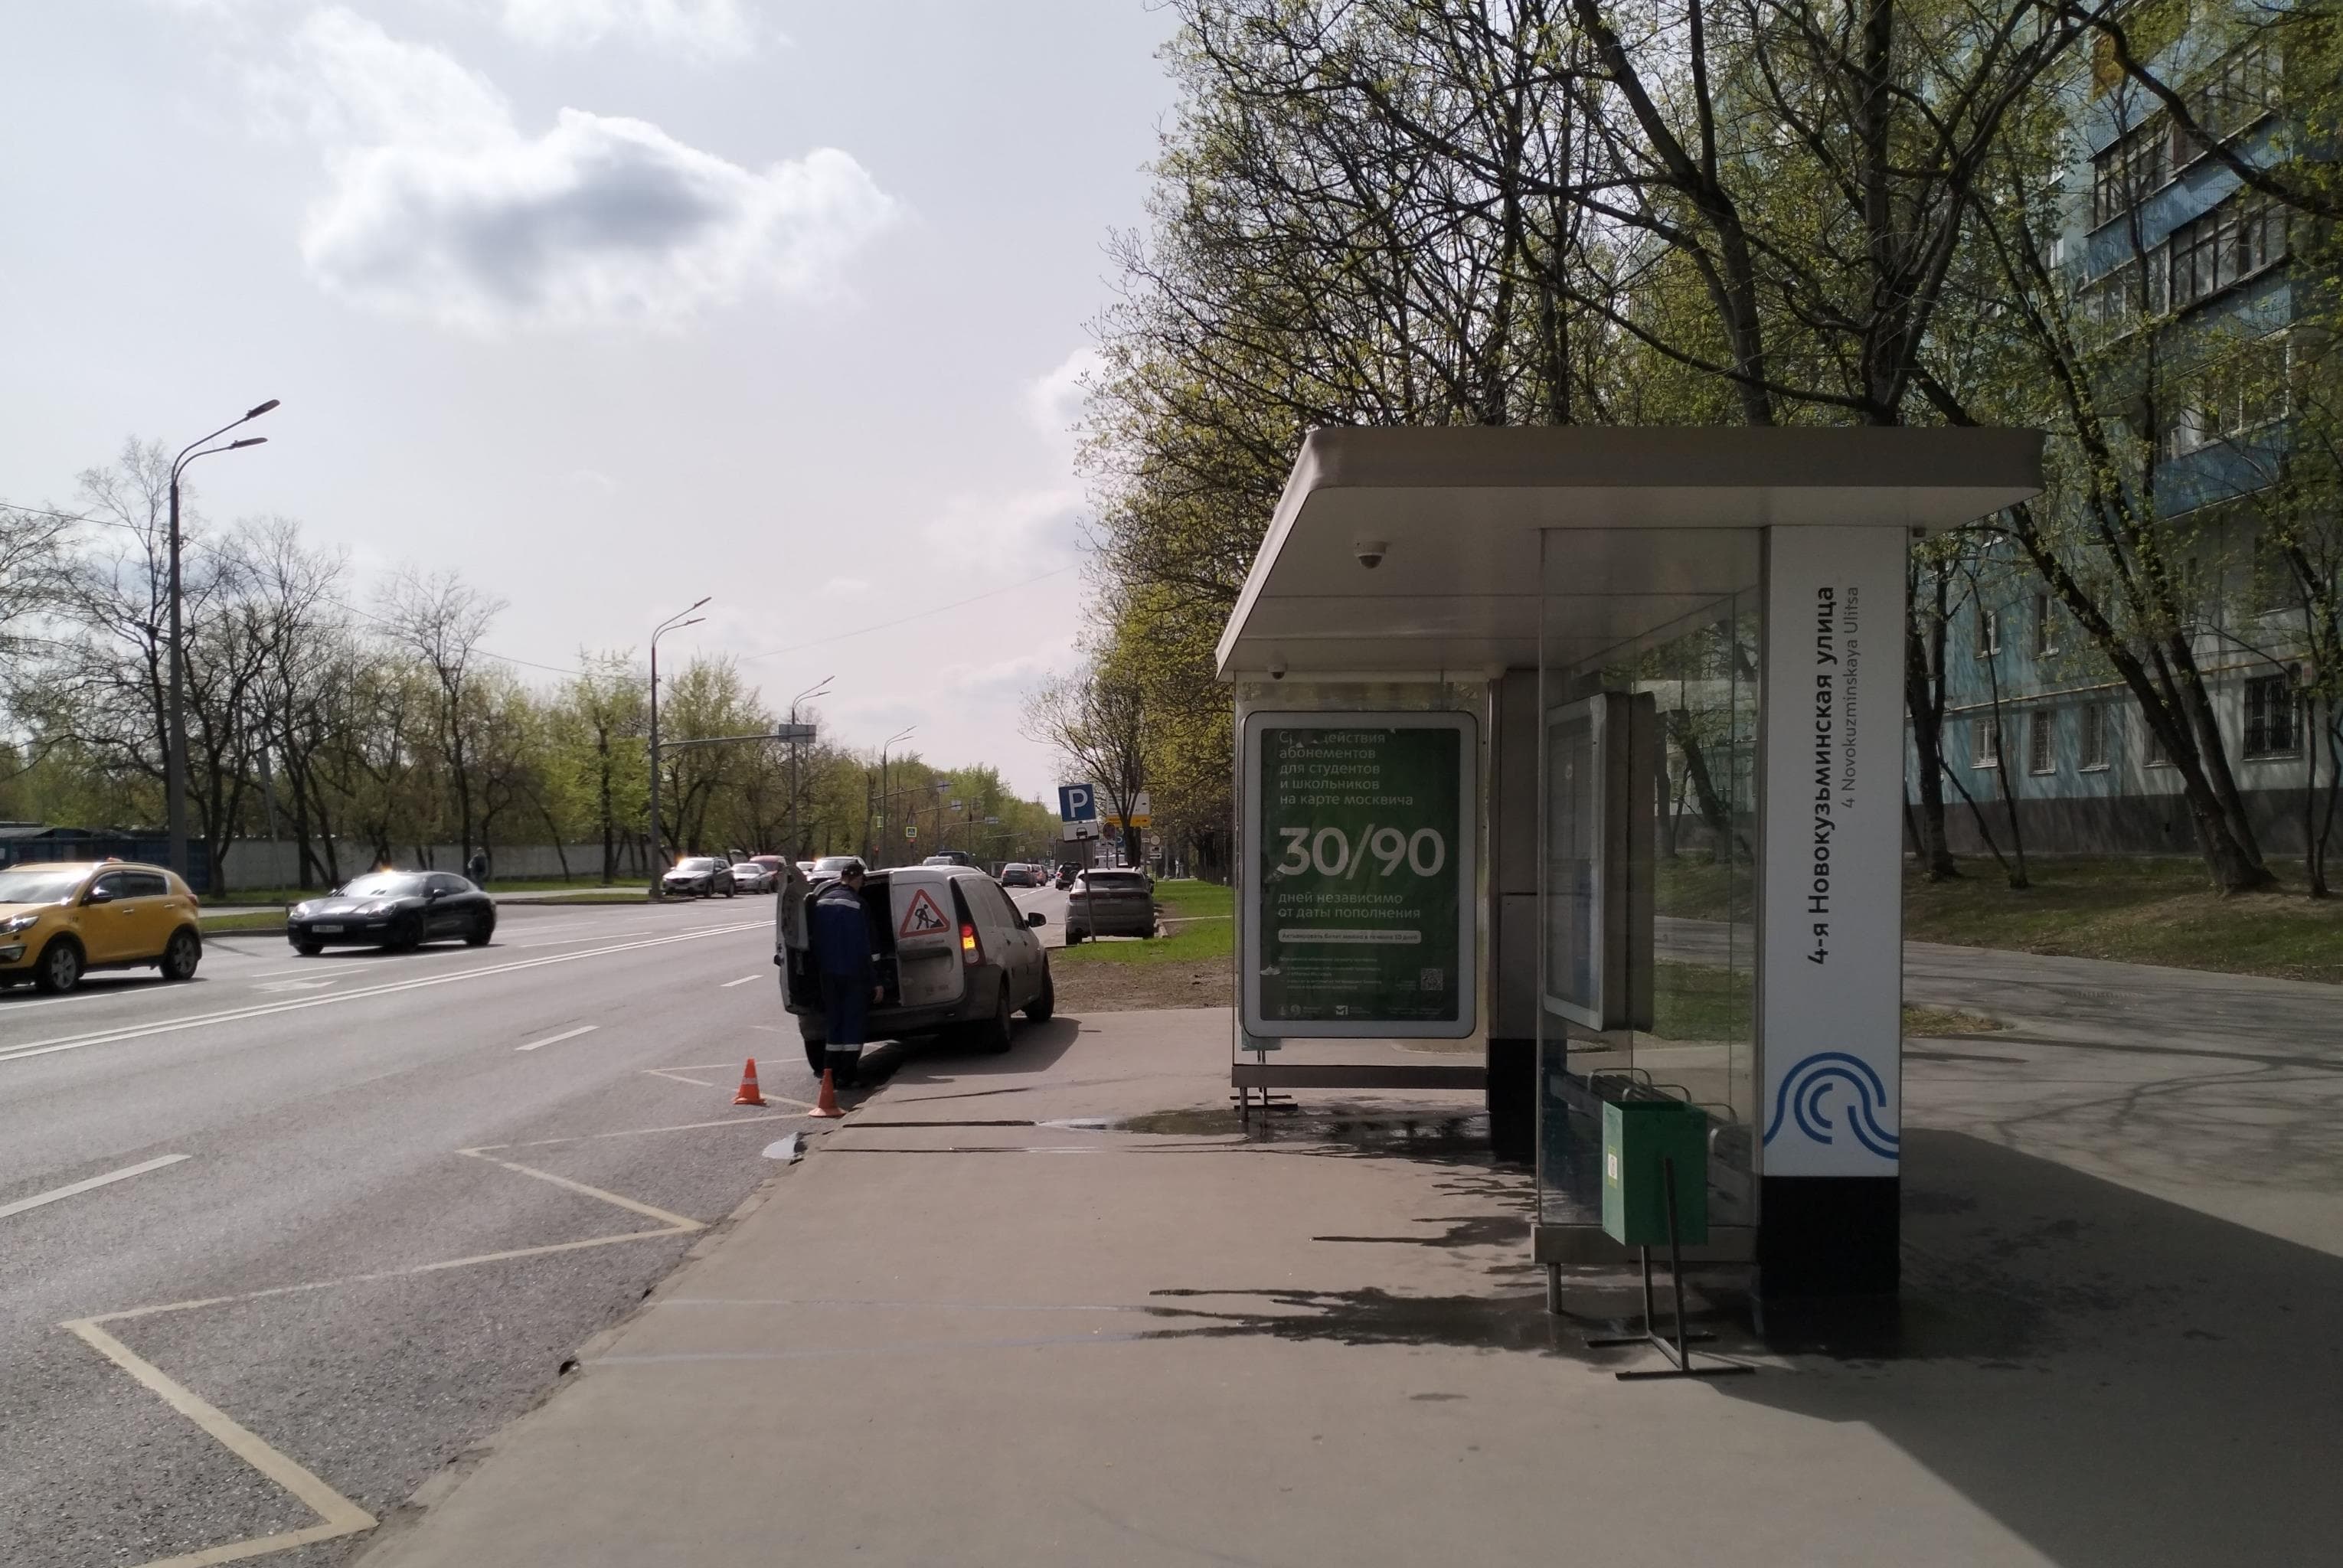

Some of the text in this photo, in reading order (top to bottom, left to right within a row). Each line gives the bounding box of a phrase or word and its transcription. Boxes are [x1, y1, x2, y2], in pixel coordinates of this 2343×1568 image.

[1841, 586, 1861, 808] 4 Novokuzminskaya Ulitsa
[1279, 746, 1377, 760] абонементов
[1279, 764, 1381, 776] для студентов
[1807, 586, 1838, 965] 4-я Новокузьминская улица
[1279, 780, 1380, 789] и школьников
[1279, 795, 1413, 807] на карте москвича
[1278, 823, 1445, 880] 30/90
[1278, 891, 1403, 904] дней независимо
[1278, 908, 1421, 920] от даты пополнения
